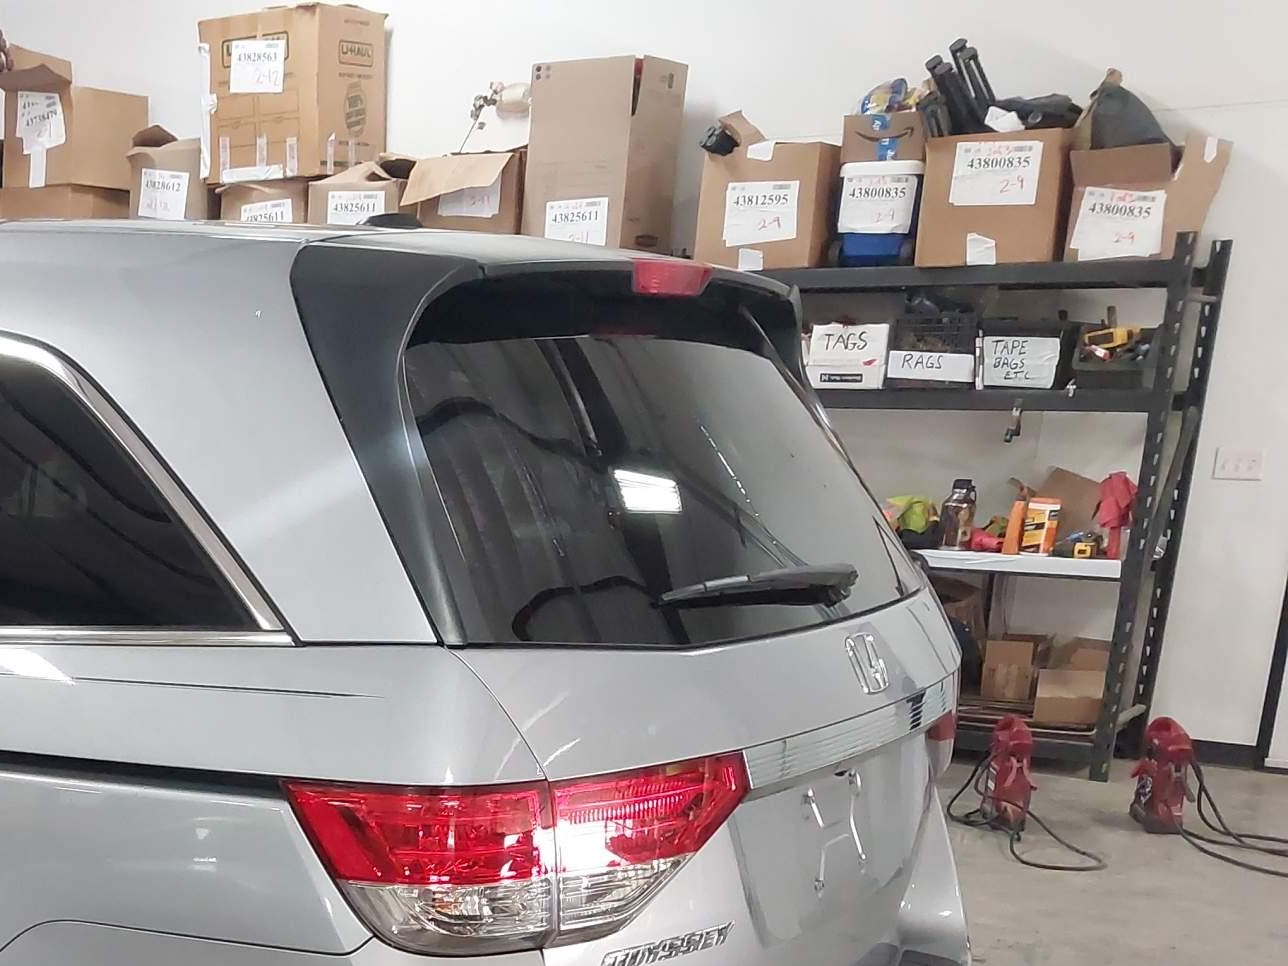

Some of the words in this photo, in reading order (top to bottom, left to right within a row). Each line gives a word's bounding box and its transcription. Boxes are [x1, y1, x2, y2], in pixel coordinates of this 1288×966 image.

[968, 156, 1031, 169] 43800835
[733, 194, 789, 206] 43812595
[849, 187, 906, 199] 43800835
[552, 210, 598, 224] 43825611
[1088, 202, 1152, 219] 43800835
[824, 331, 868, 351] TAGS
[992, 339, 1029, 355] TAPE
[901, 354, 944, 369] RAGS
[993, 357, 1025, 370] BAGS
